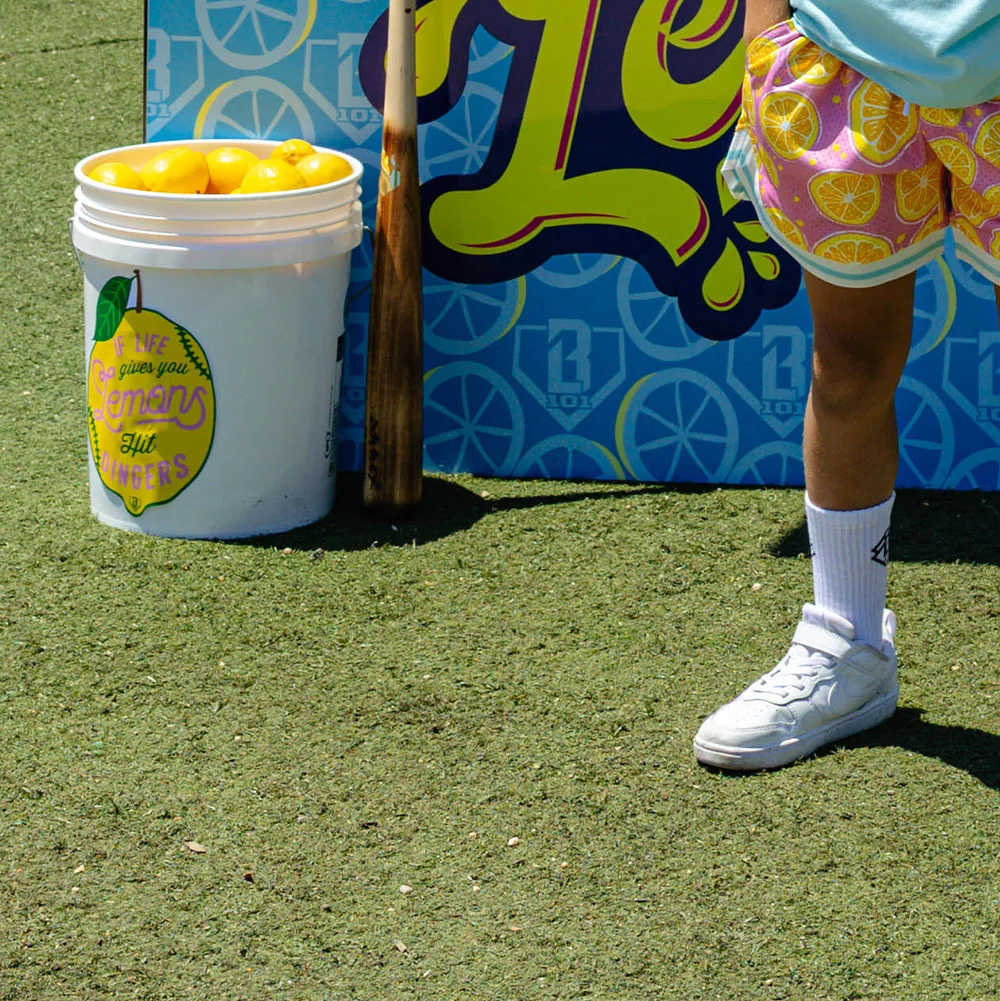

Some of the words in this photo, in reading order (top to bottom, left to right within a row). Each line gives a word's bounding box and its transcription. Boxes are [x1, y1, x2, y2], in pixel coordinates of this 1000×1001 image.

[114, 335, 125, 357] IF
[135, 333, 170, 355] LIFE
[118, 360, 154, 380] gives
[157, 361, 189, 379] you
[92, 358, 207, 433] Lemons
[120, 432, 157, 457] Hit
[100, 453, 189, 491] DINGERS
